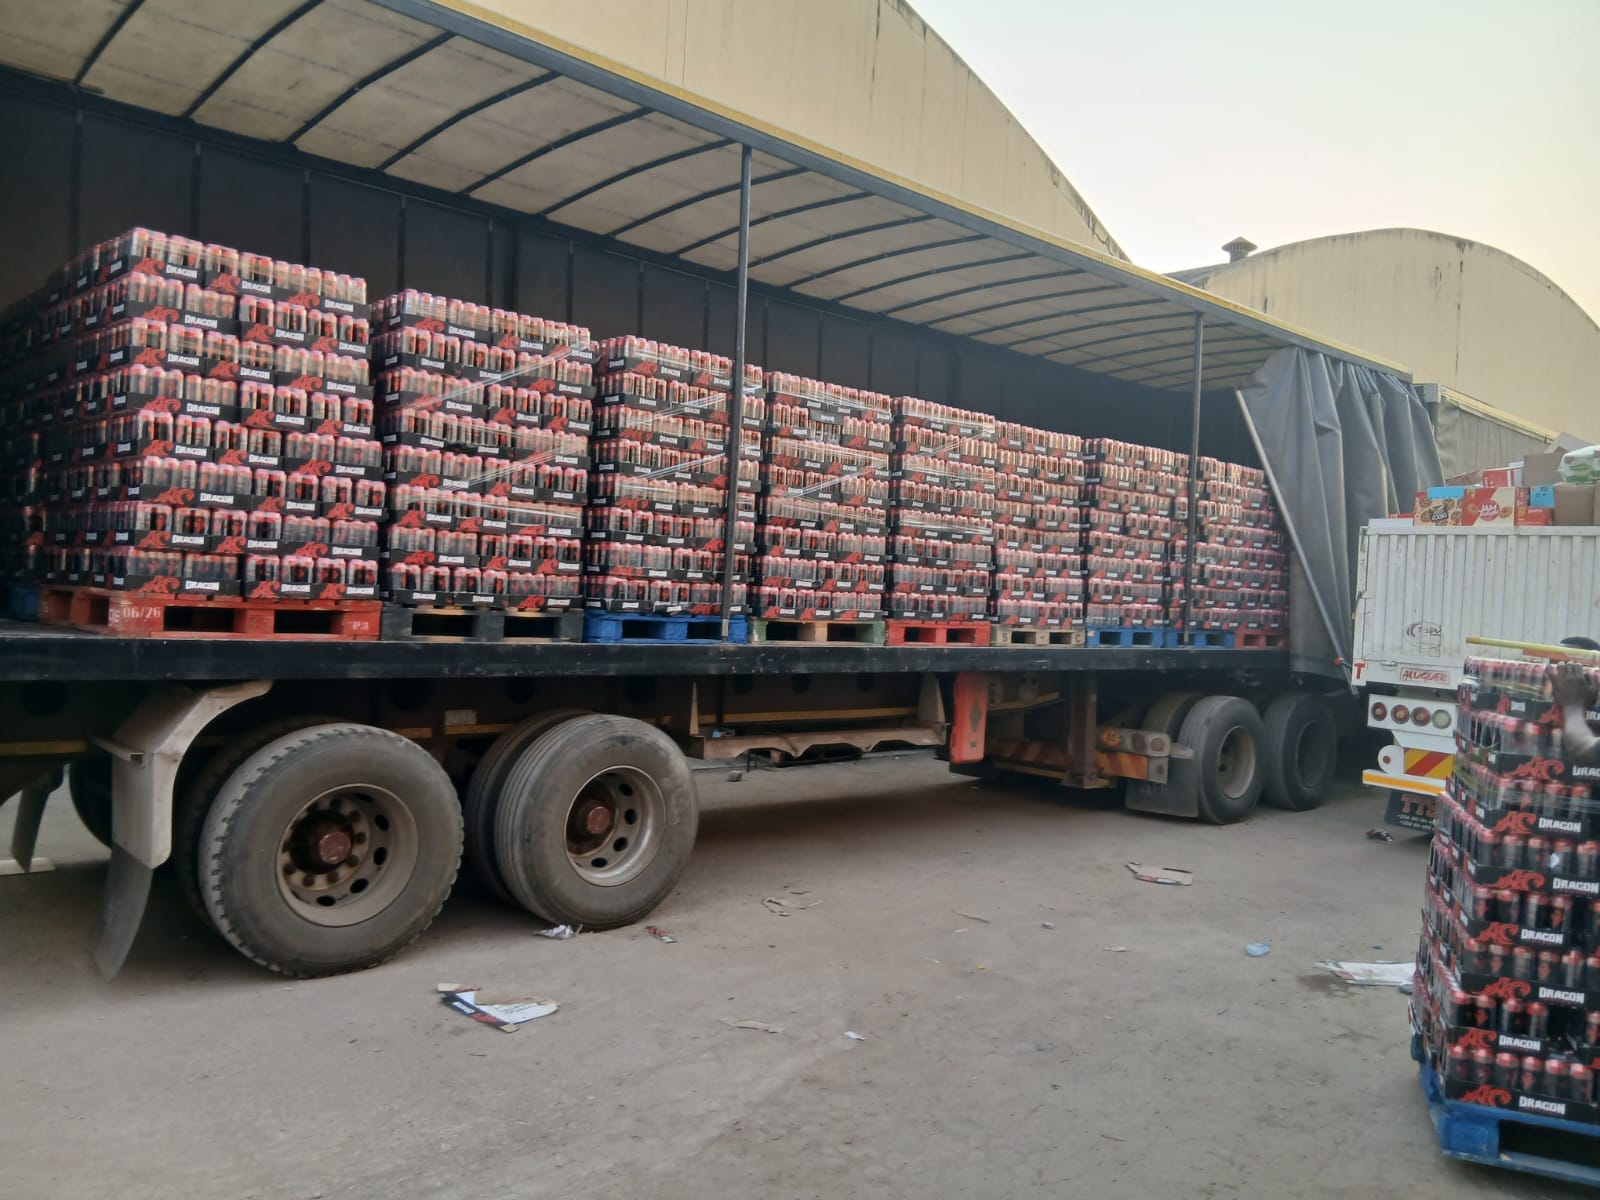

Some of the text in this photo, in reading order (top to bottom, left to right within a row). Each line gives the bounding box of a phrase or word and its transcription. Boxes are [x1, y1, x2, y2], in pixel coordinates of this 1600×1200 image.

[166, 264, 198, 279] DRAGON
[185, 315, 218, 329] DRAGON
[167, 353, 199, 366] DRAGON
[1354, 663, 1366, 680] T
[1538, 817, 1582, 833] DRAGON
[1552, 878, 1600, 895] DRAGON
[1520, 929, 1564, 945] DRAGON
[1538, 987, 1585, 1004] DRAGON
[1499, 1035, 1541, 1051] DRAGON
[1519, 1096, 1566, 1115] DRAGON
